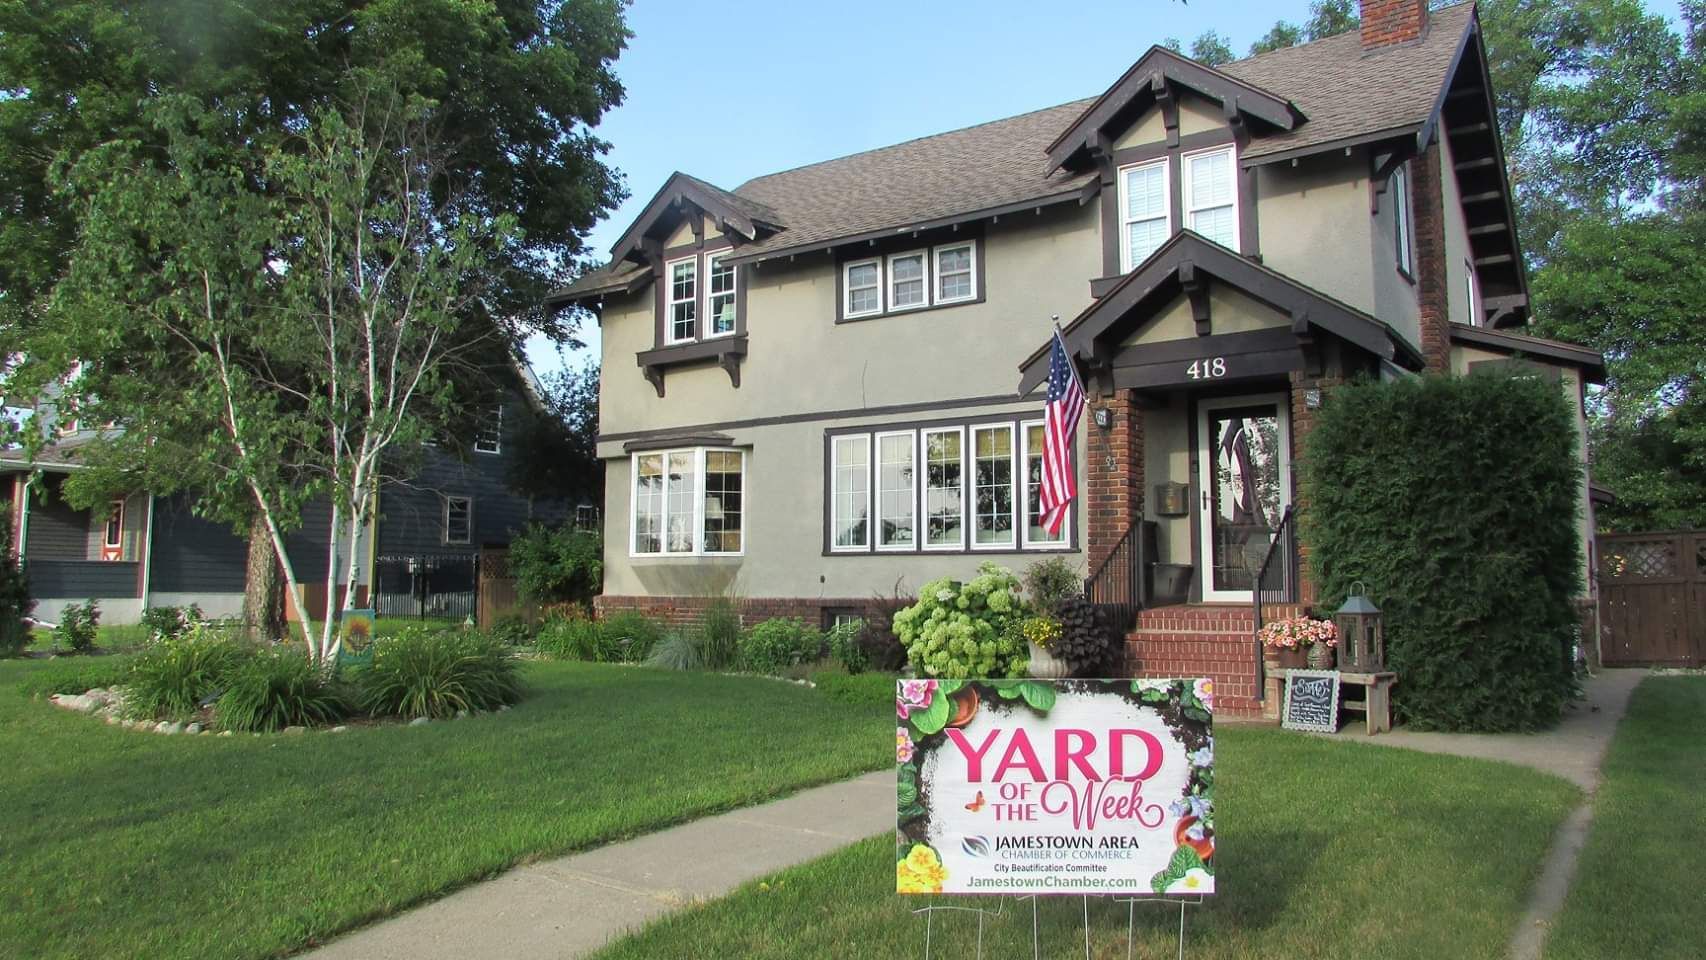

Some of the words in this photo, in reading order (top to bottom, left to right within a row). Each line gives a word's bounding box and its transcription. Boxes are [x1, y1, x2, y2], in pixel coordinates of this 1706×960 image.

[1186, 357, 1226, 379] 418
[944, 727, 1164, 783] YARD
[1000, 782, 1032, 800] OF
[991, 803, 1038, 821] THE
[1040, 775, 1164, 830] Week
[995, 836, 1093, 851] JAMESTOWN
[1098, 836, 1139, 849] AREA
[1001, 849, 1051, 859] CHAMBER
[1054, 850, 1069, 859] OF
[1071, 850, 1132, 859] COMMERCE
[994, 863, 1010, 873] City
[1011, 863, 1064, 873] Beautification
[1065, 863, 1107, 872] Committee
[966, 876, 1137, 888] JamestownChamber.com
